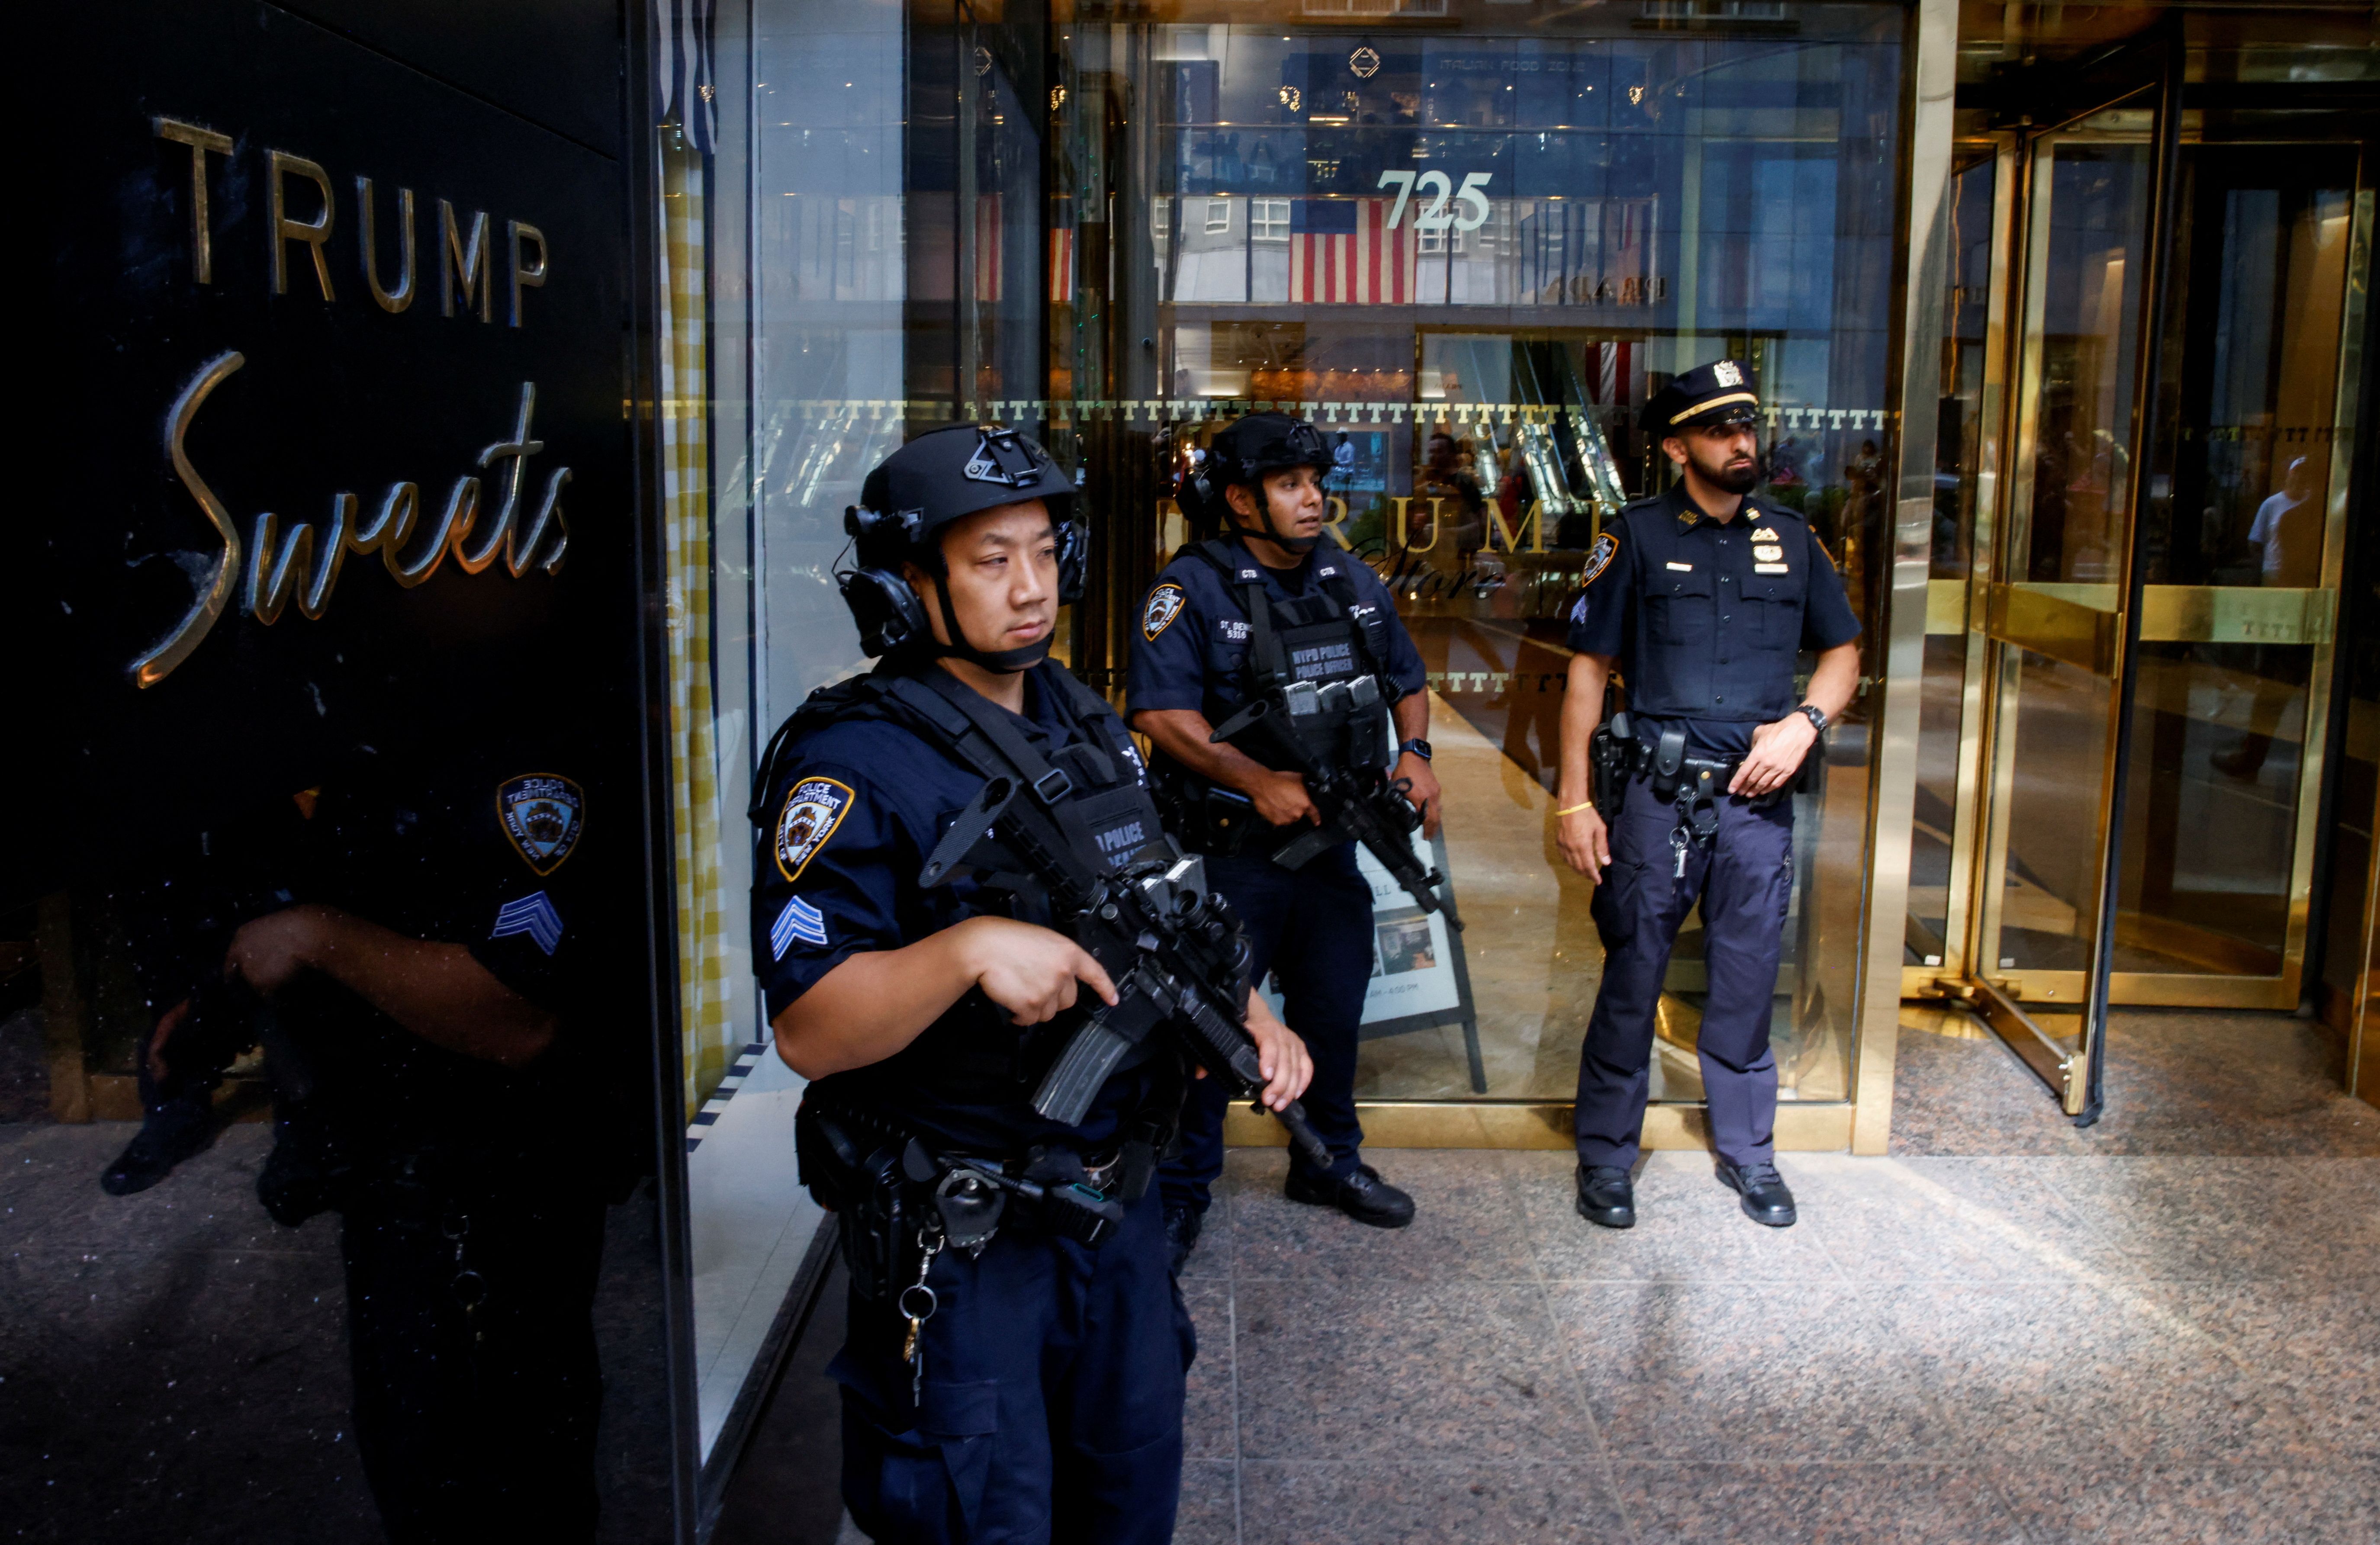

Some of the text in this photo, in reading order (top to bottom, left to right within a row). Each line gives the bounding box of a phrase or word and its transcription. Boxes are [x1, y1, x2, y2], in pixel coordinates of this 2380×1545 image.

[152, 116, 548, 328] TRUMP
[1377, 169, 1493, 231] 725
[129, 350, 572, 689] Sweets
[798, 783, 832, 795] POLICE
[1103, 821, 1145, 852] POLICE
